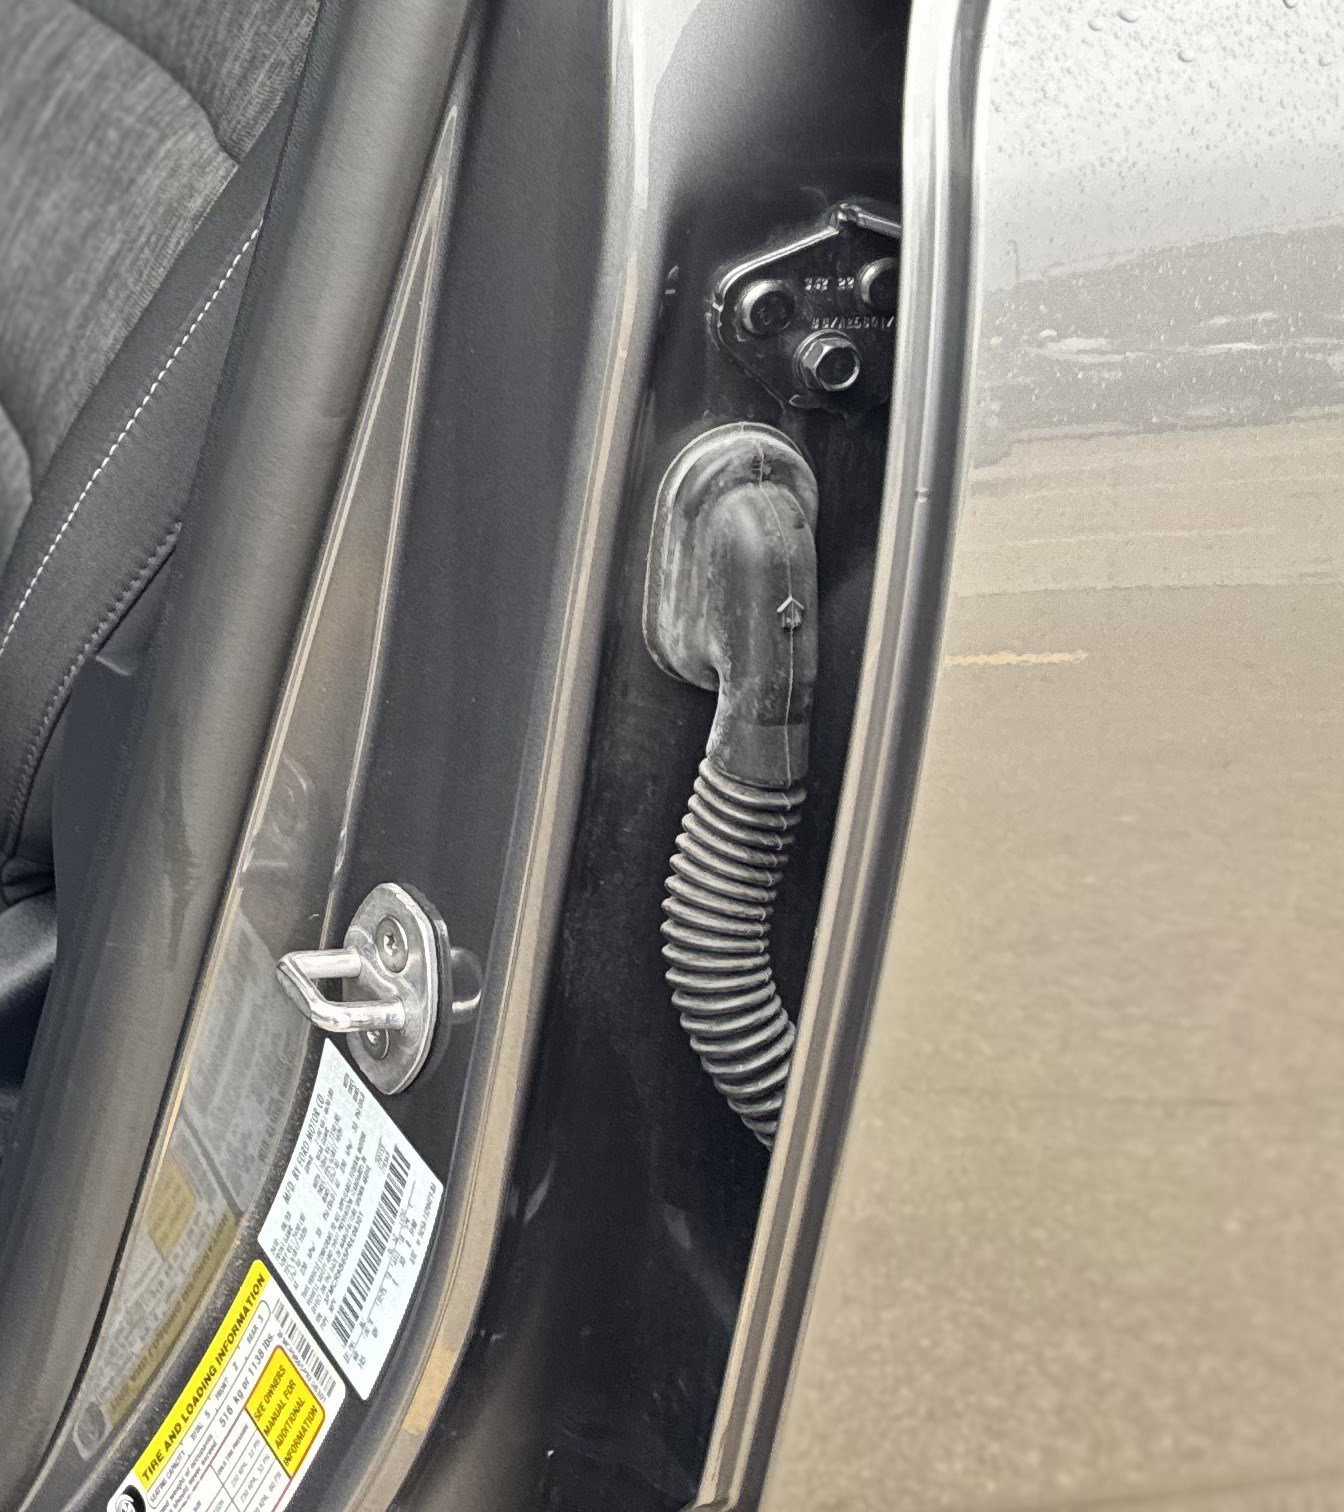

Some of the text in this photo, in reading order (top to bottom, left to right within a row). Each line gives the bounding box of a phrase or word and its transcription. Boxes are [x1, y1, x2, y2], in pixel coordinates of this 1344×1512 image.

[141, 1272, 265, 1483] TIRE AND LOADING INFORMATION
[218, 1403, 233, 1428] 516
[232, 1387, 244, 1404] kg
[241, 1375, 249, 1390] or
[247, 1346, 264, 1377] 1138
[253, 1363, 286, 1422] SEE OWNERS
[263, 1376, 296, 1437] MANUAL FOR
[274, 1394, 305, 1450] ADDITIONAL
[282, 1403, 317, 1467] INFORMATION
